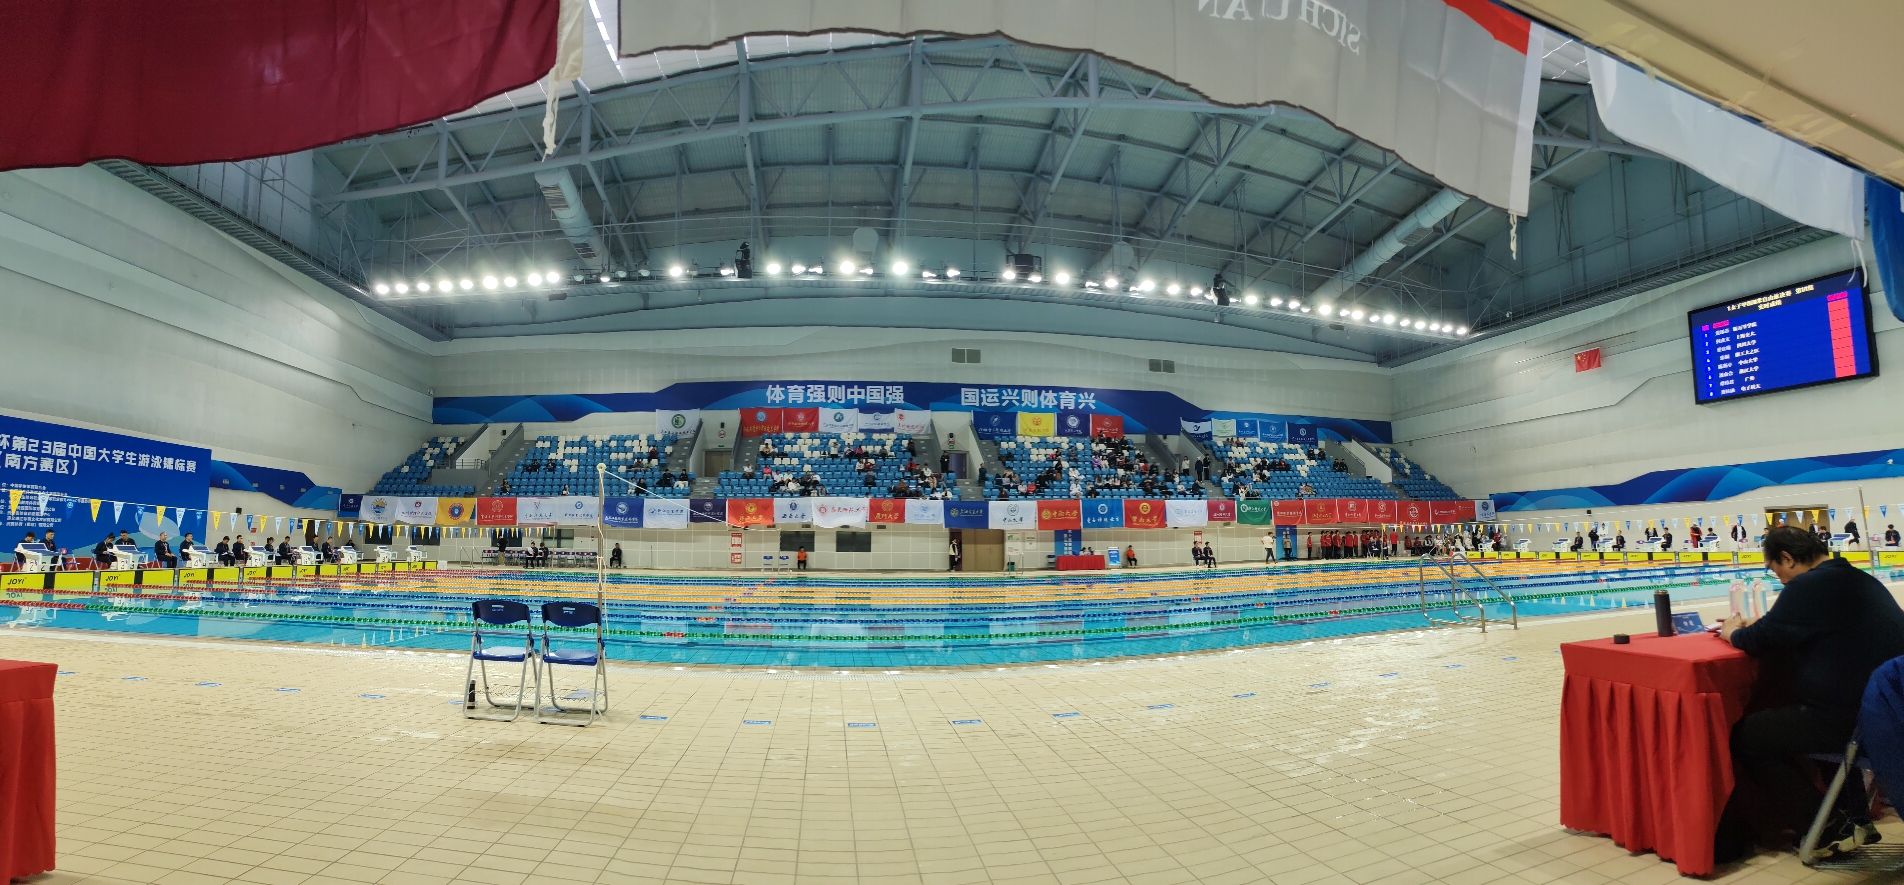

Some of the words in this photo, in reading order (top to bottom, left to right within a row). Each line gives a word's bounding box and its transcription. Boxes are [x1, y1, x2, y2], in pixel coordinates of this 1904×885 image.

[766, 384, 905, 405] 体育强则中国强
[961, 387, 1097, 410] 国运兴则体育兴
[0, 450, 78, 476] 南方赛区)
